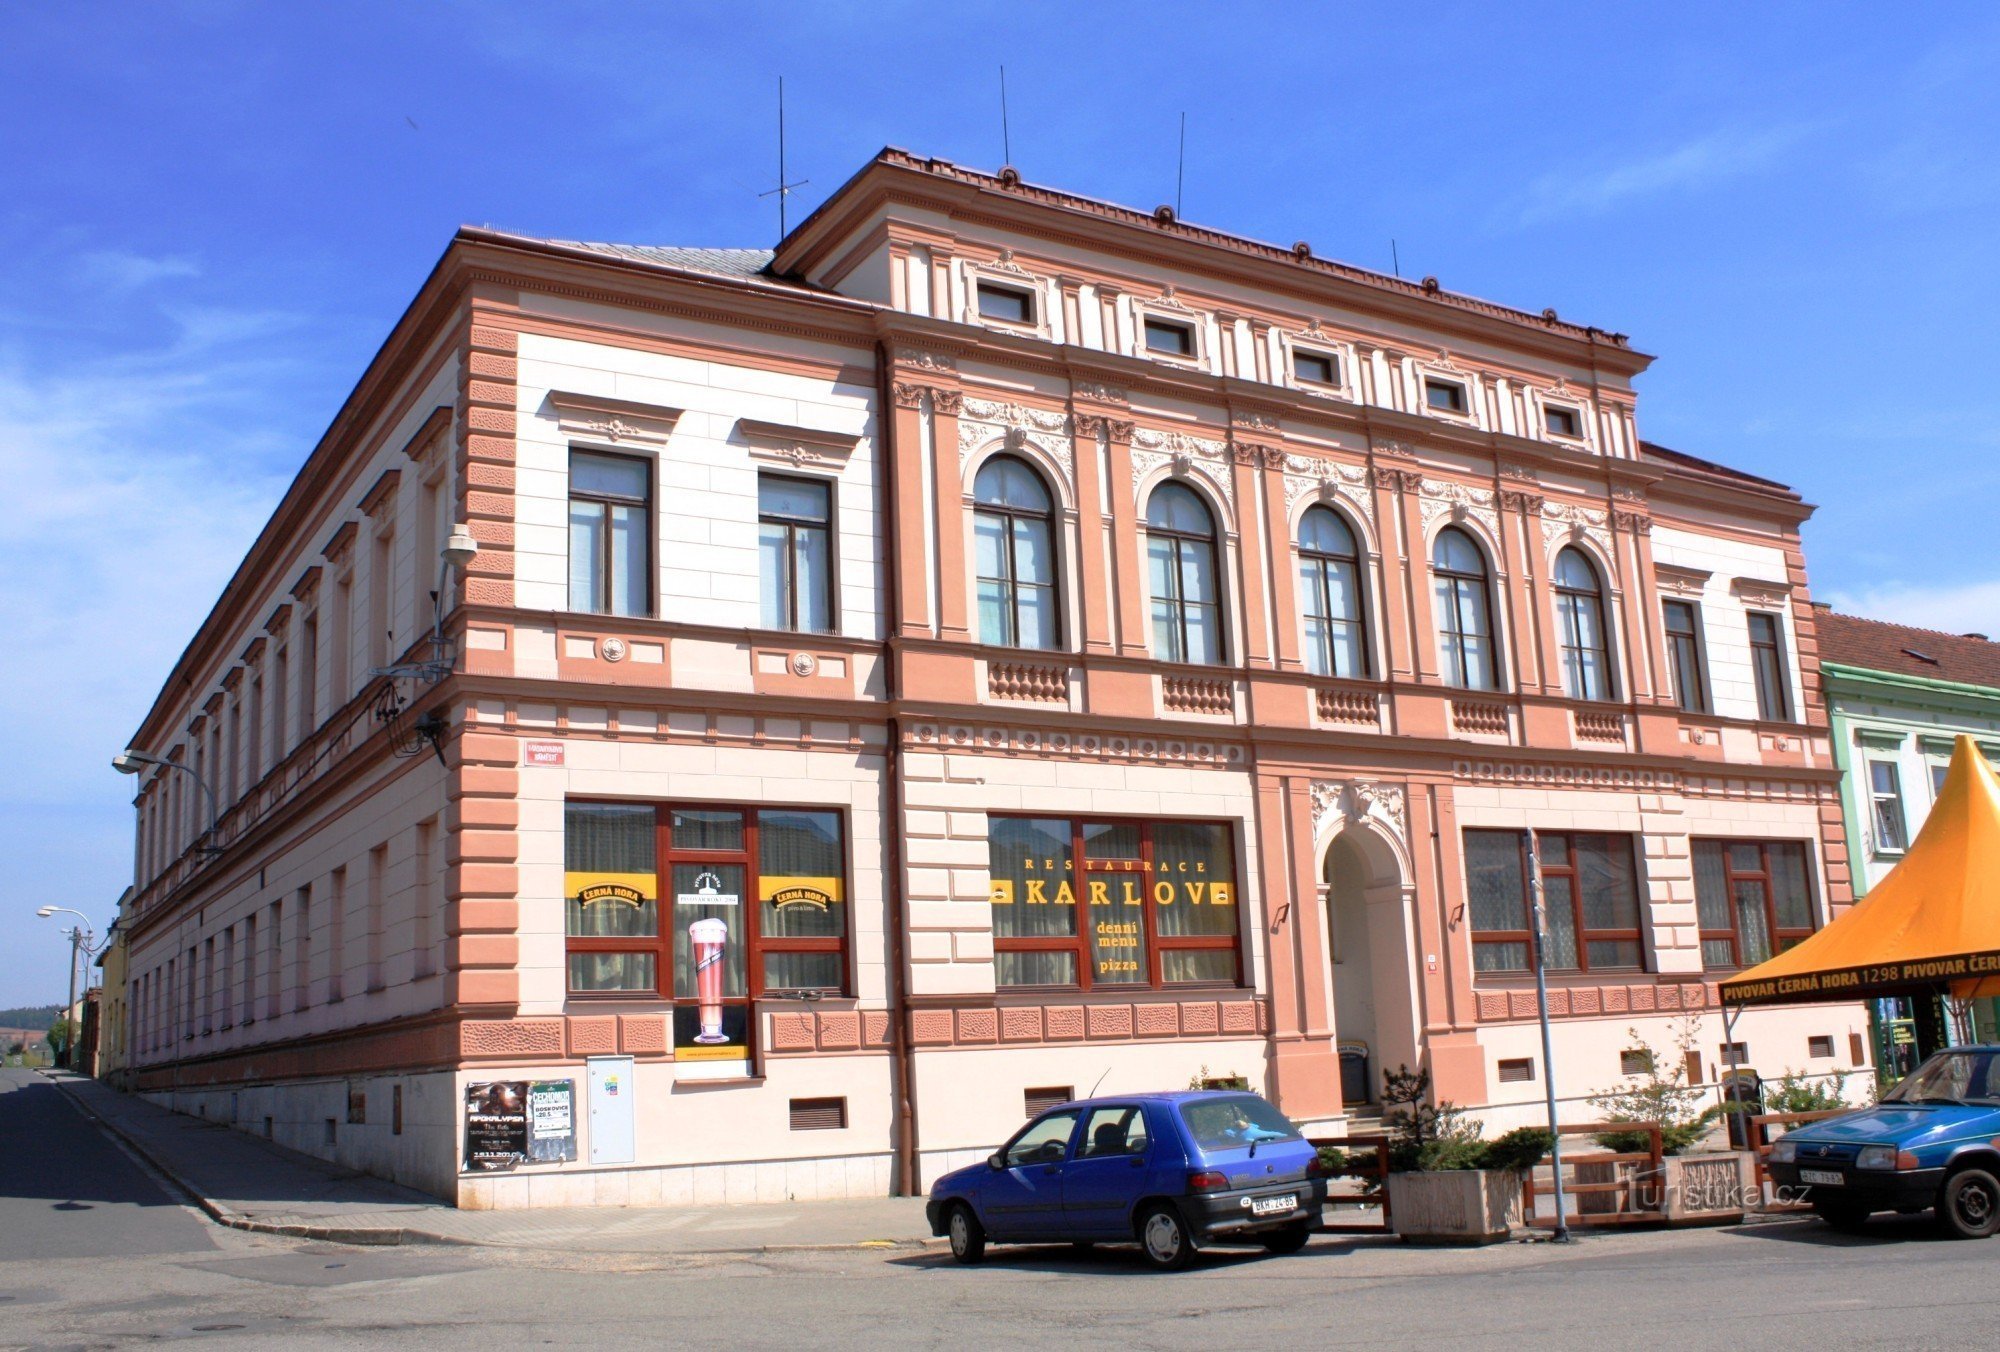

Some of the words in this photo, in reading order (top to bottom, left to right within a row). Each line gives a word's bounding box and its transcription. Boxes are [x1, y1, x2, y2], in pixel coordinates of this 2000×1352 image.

[1025, 859, 1206, 872] RESTAURACE
[583, 886, 613, 901] ČERNÁ
[614, 888, 639, 902] HORA
[777, 889, 803, 903] ČERNÁ
[804, 891, 827, 904] HORA
[1025, 880, 1205, 905] KARLOV
[1096, 921, 1138, 934] denní
[1098, 936, 1138, 947] menu
[1099, 957, 1138, 973] pizza
[1723, 982, 1776, 1000] PIVOVAR
[1778, 974, 1820, 994] ČERNÁ
[1821, 971, 1860, 989] HORA
[1862, 966, 1899, 983] 1298
[1903, 959, 1966, 979] PIVOVAR
